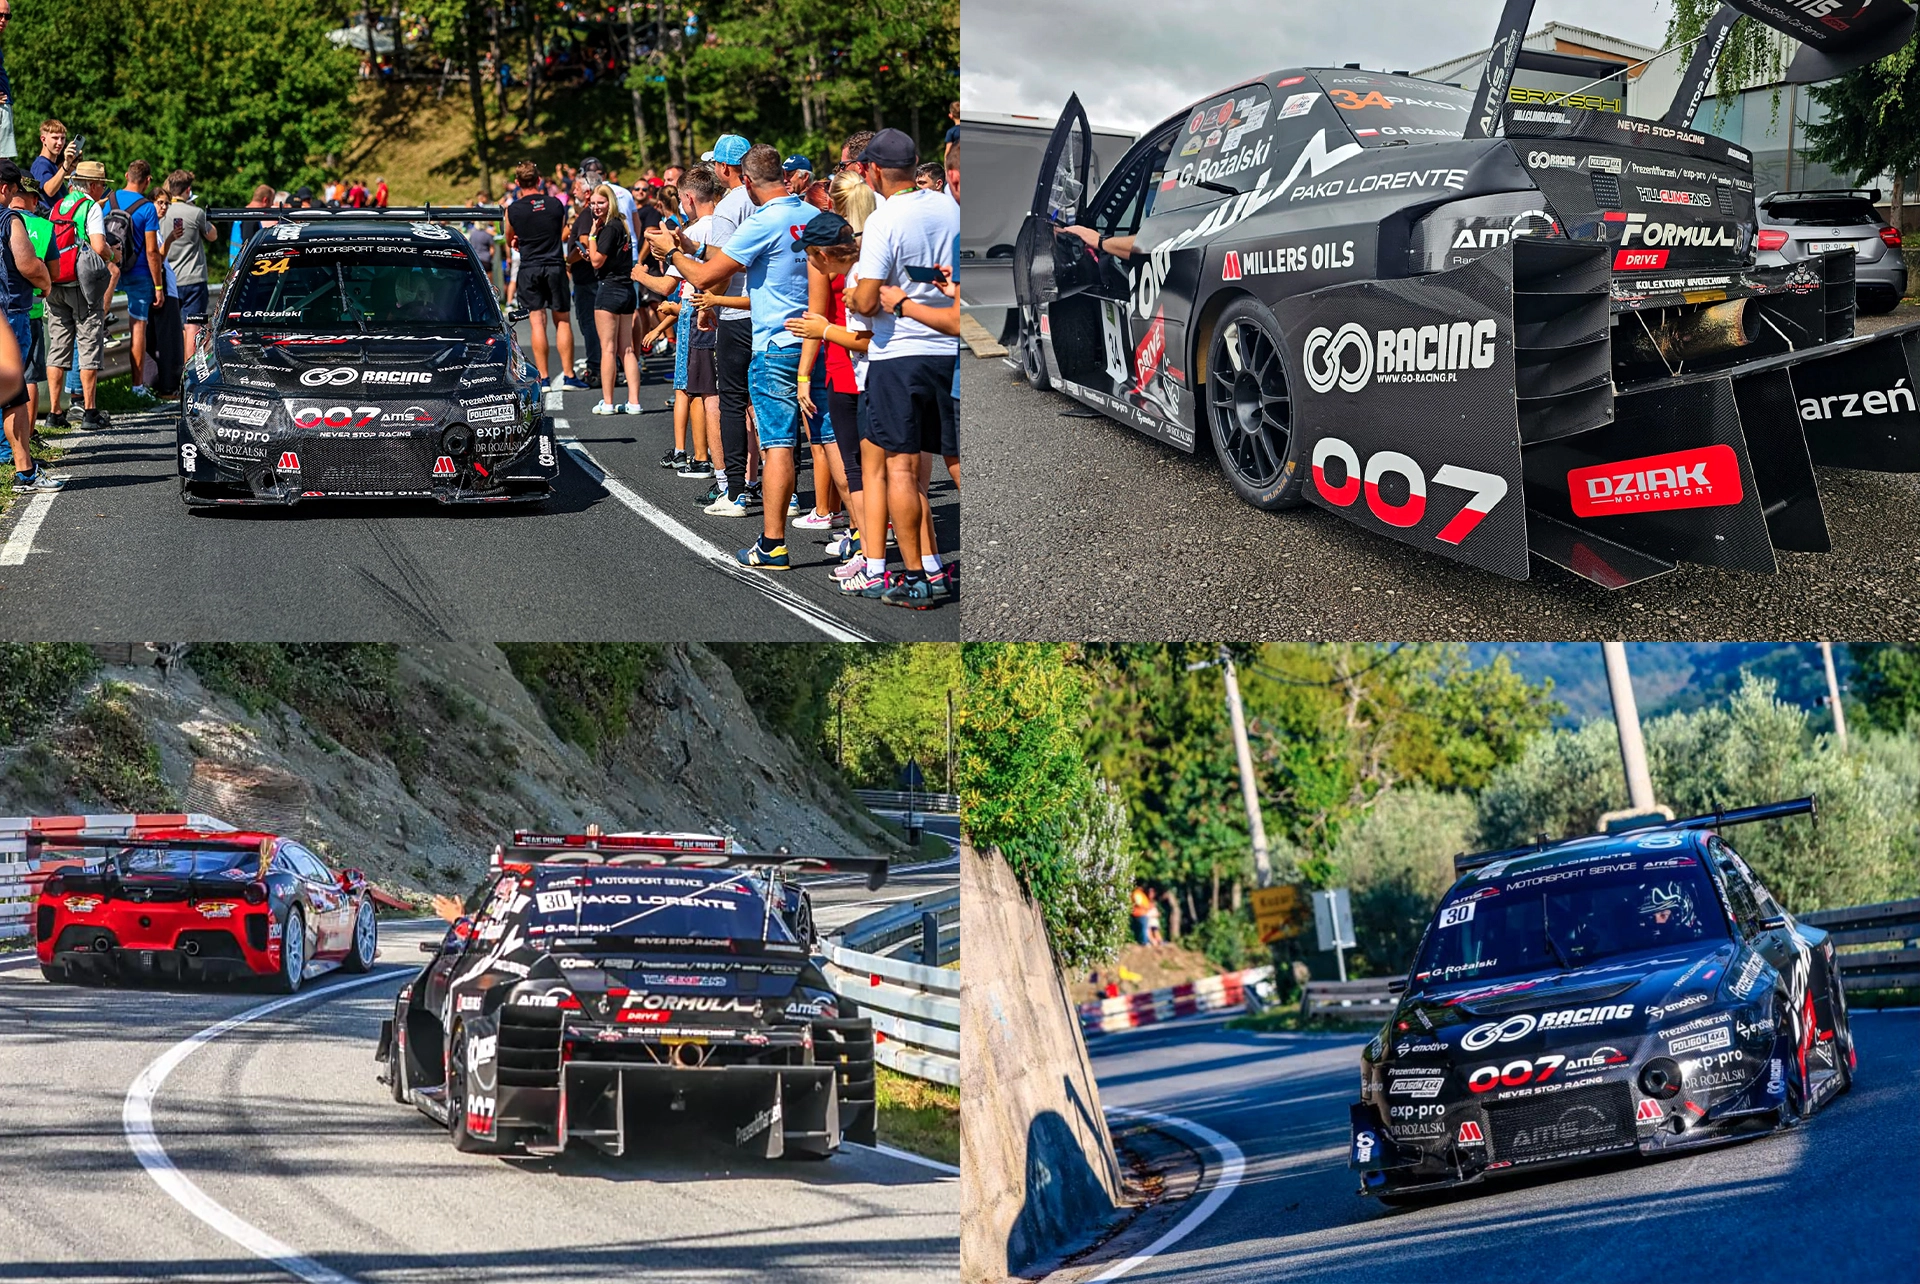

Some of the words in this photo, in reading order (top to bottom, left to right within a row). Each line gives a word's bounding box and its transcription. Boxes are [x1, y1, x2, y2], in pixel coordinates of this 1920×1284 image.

[1687, 79, 1706, 119] STOP
[1702, 24, 1730, 79] RACING
[1387, 96, 1457, 113] PAKO
[1509, 86, 1622, 113] BRATSCHI
[1616, 119, 1650, 134] NEVER
[1652, 126, 1676, 139] STOP
[1676, 131, 1705, 145] RACING
[1178, 134, 1274, 189] G.Rożalski
[1550, 154, 1576, 167] RACING
[1289, 179, 1343, 203] PAKO
[1345, 168, 1469, 196] LORENTE
[1620, 213, 1736, 247] FORMULA
[305, 245, 374, 254] MOTORSPORT
[376, 246, 418, 254] SERVICE
[1242, 245, 1307, 275] MILLERS
[1314, 239, 1356, 270] OILS
[251, 258, 290, 276] 34
[1625, 254, 1659, 266] DRIVE
[1635, 278, 1686, 290] KOLEKTORY
[1136, 324, 1162, 380] DRIVE
[1376, 318, 1497, 374] RACING
[249, 364, 293, 373] LORENTE
[361, 370, 433, 384] RACING
[1376, 371, 1458, 384] WWW.GO-RACING.PL
[294, 406, 382, 429] 007
[380, 413, 415, 421] AMS
[378, 430, 411, 438] RACING
[1585, 461, 1712, 502] DZIAK
[1310, 436, 1508, 546] 007
[1613, 485, 1714, 505] MOTORSPORT
[521, 836, 542, 844] PEAK
[673, 839, 694, 848] PEAK
[1511, 862, 1556, 877] PAKO
[1558, 851, 1632, 867] LORENTE
[1642, 859, 1679, 868] AMS
[594, 876, 663, 886] MOTORSPORT
[664, 877, 704, 888] SERVICE
[1505, 868, 1587, 891] MOTORSPORT
[1589, 861, 1638, 876] SERVICE
[544, 893, 566, 909] 30
[572, 894, 632, 906] PAKO
[636, 894, 737, 910] LORENTE
[1450, 891, 1484, 906] AMS
[1445, 904, 1470, 926] 30
[634, 937, 667, 945] NEVER
[668, 938, 694, 946] STOP
[695, 938, 731, 947] RACING
[1431, 957, 1498, 978] G.Rożalski
[516, 995, 559, 1007] AMS
[621, 989, 757, 1012] FORMULA
[785, 1002, 822, 1015] AMS
[1664, 993, 1708, 1012] emotivo
[626, 1012, 660, 1021] DRIVE
[1538, 1003, 1635, 1028] RACING
[1411, 1042, 1449, 1053] emotivo
[1564, 1055, 1606, 1071] AMS
[1467, 1054, 1566, 1094] 007
[1684, 1077, 1698, 1090] DR
[1699, 1068, 1746, 1086] ROŻALSKI
[1498, 1087, 1533, 1100] NEVER
[1534, 1084, 1562, 1095] STOP
[1564, 1075, 1604, 1090] RACING
[467, 1094, 495, 1135] 007
[1391, 1125, 1402, 1136] DR
[1401, 1121, 1446, 1136] ROŻALSKI
[1512, 1120, 1580, 1147] AMS
